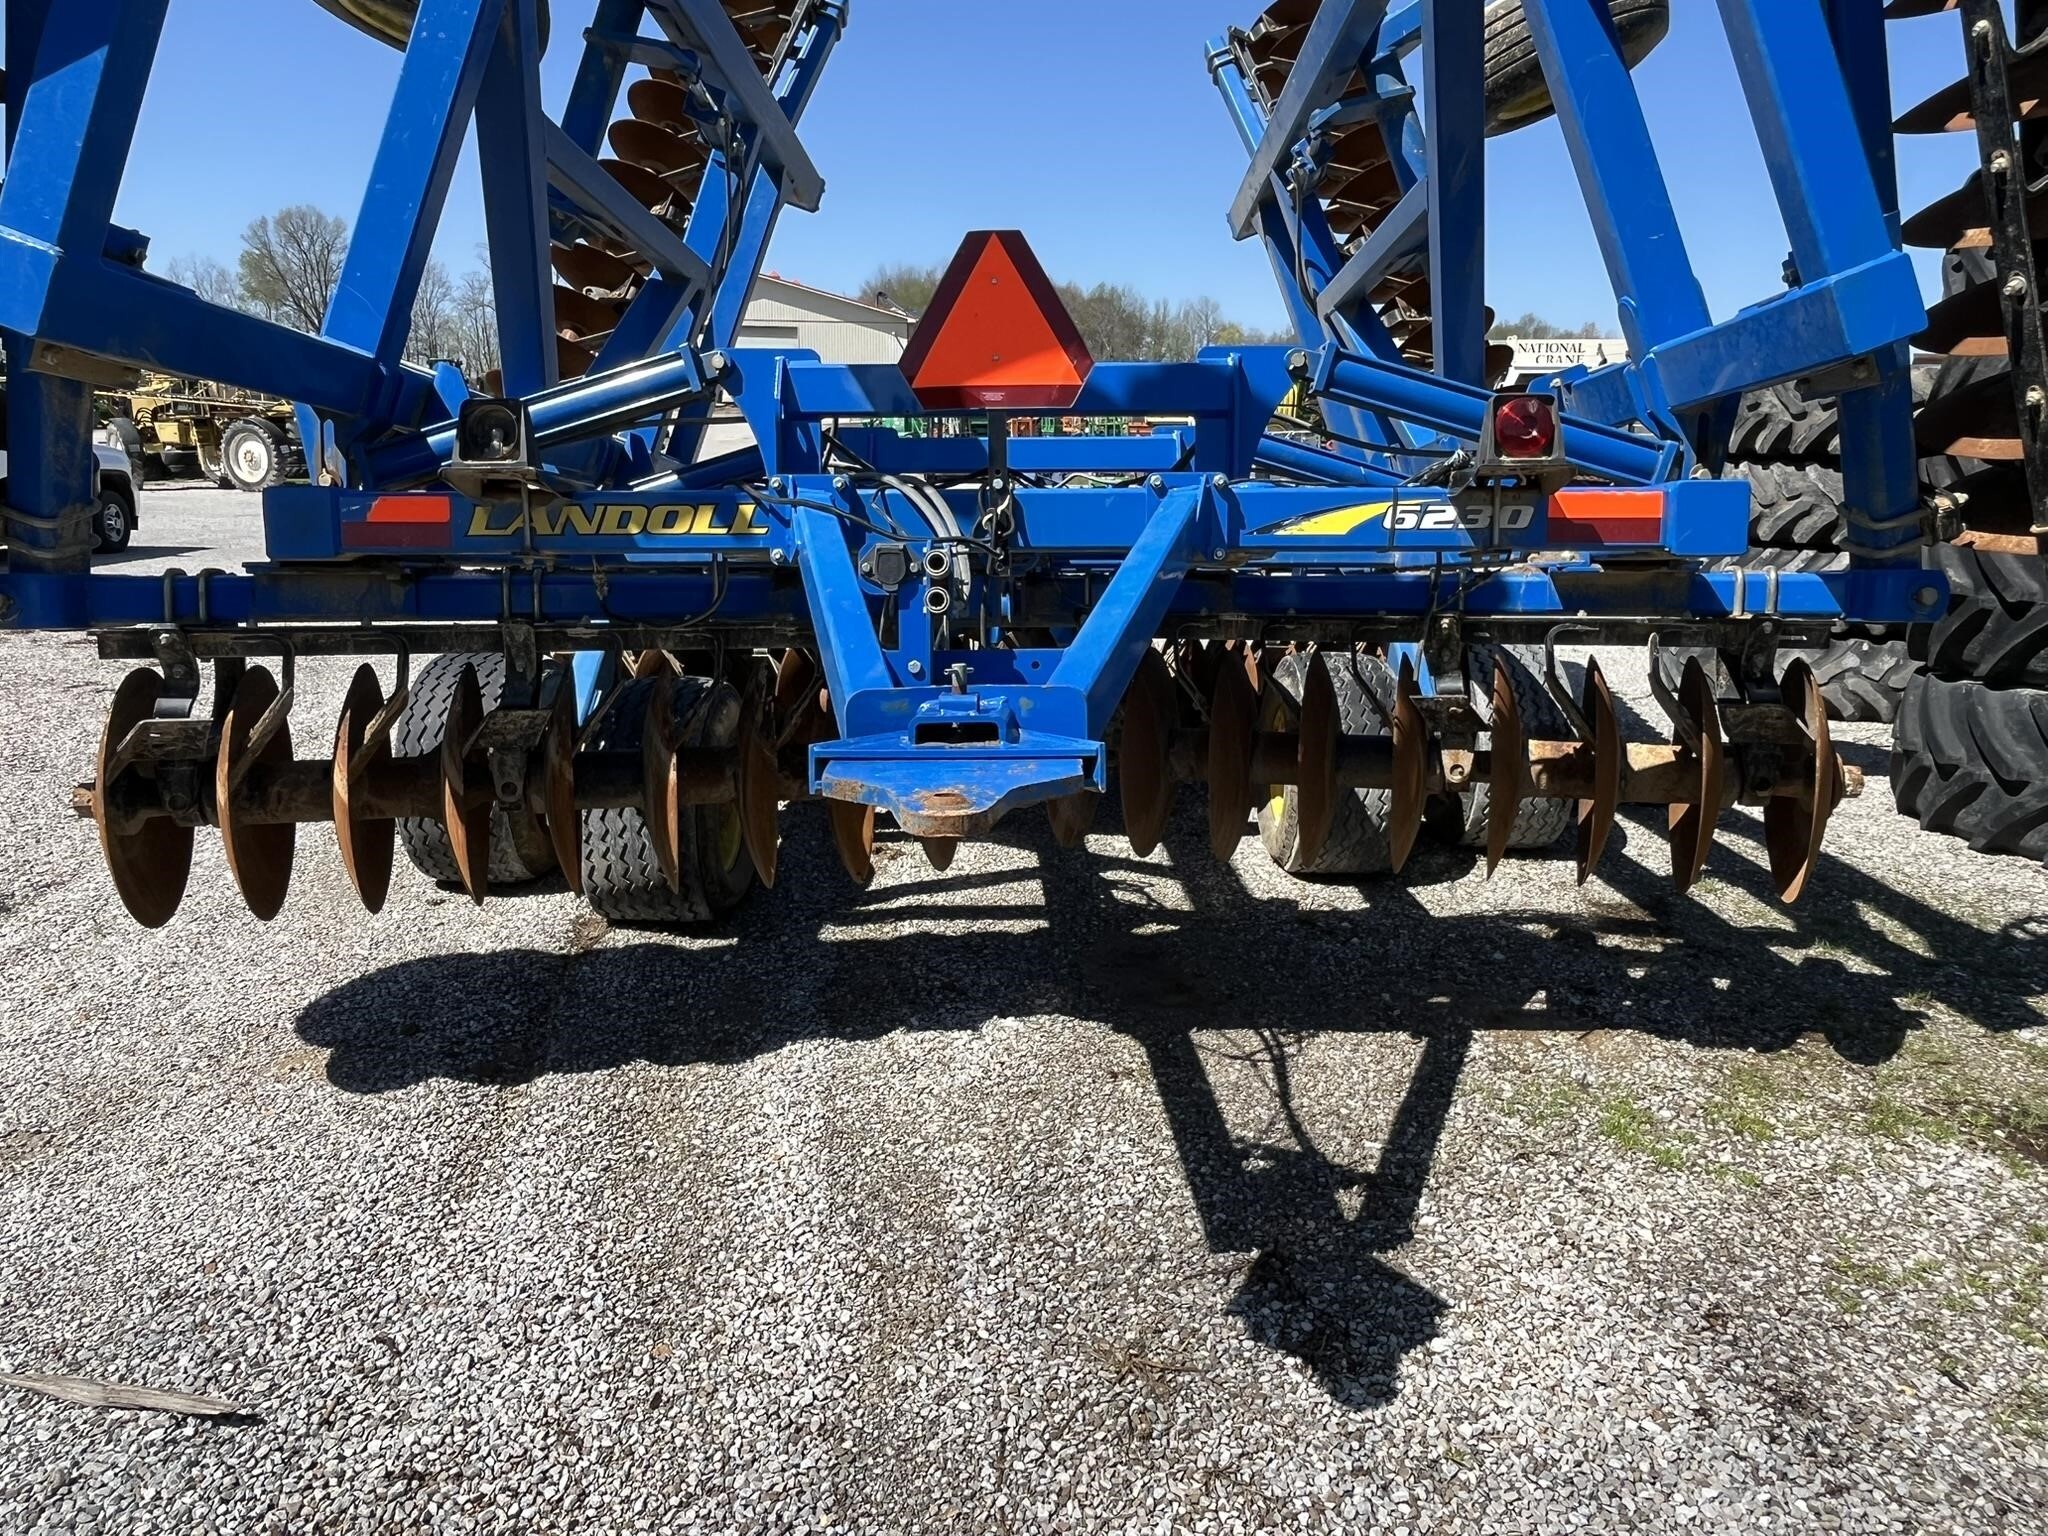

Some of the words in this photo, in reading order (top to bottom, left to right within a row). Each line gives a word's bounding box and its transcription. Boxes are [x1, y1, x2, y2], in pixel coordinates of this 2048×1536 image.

[1518, 342, 1586, 354] NATIONAL
[1535, 354, 1585, 364] CRANE
[465, 503, 770, 536] LANDOLL
[1382, 504, 1535, 530] 6230
